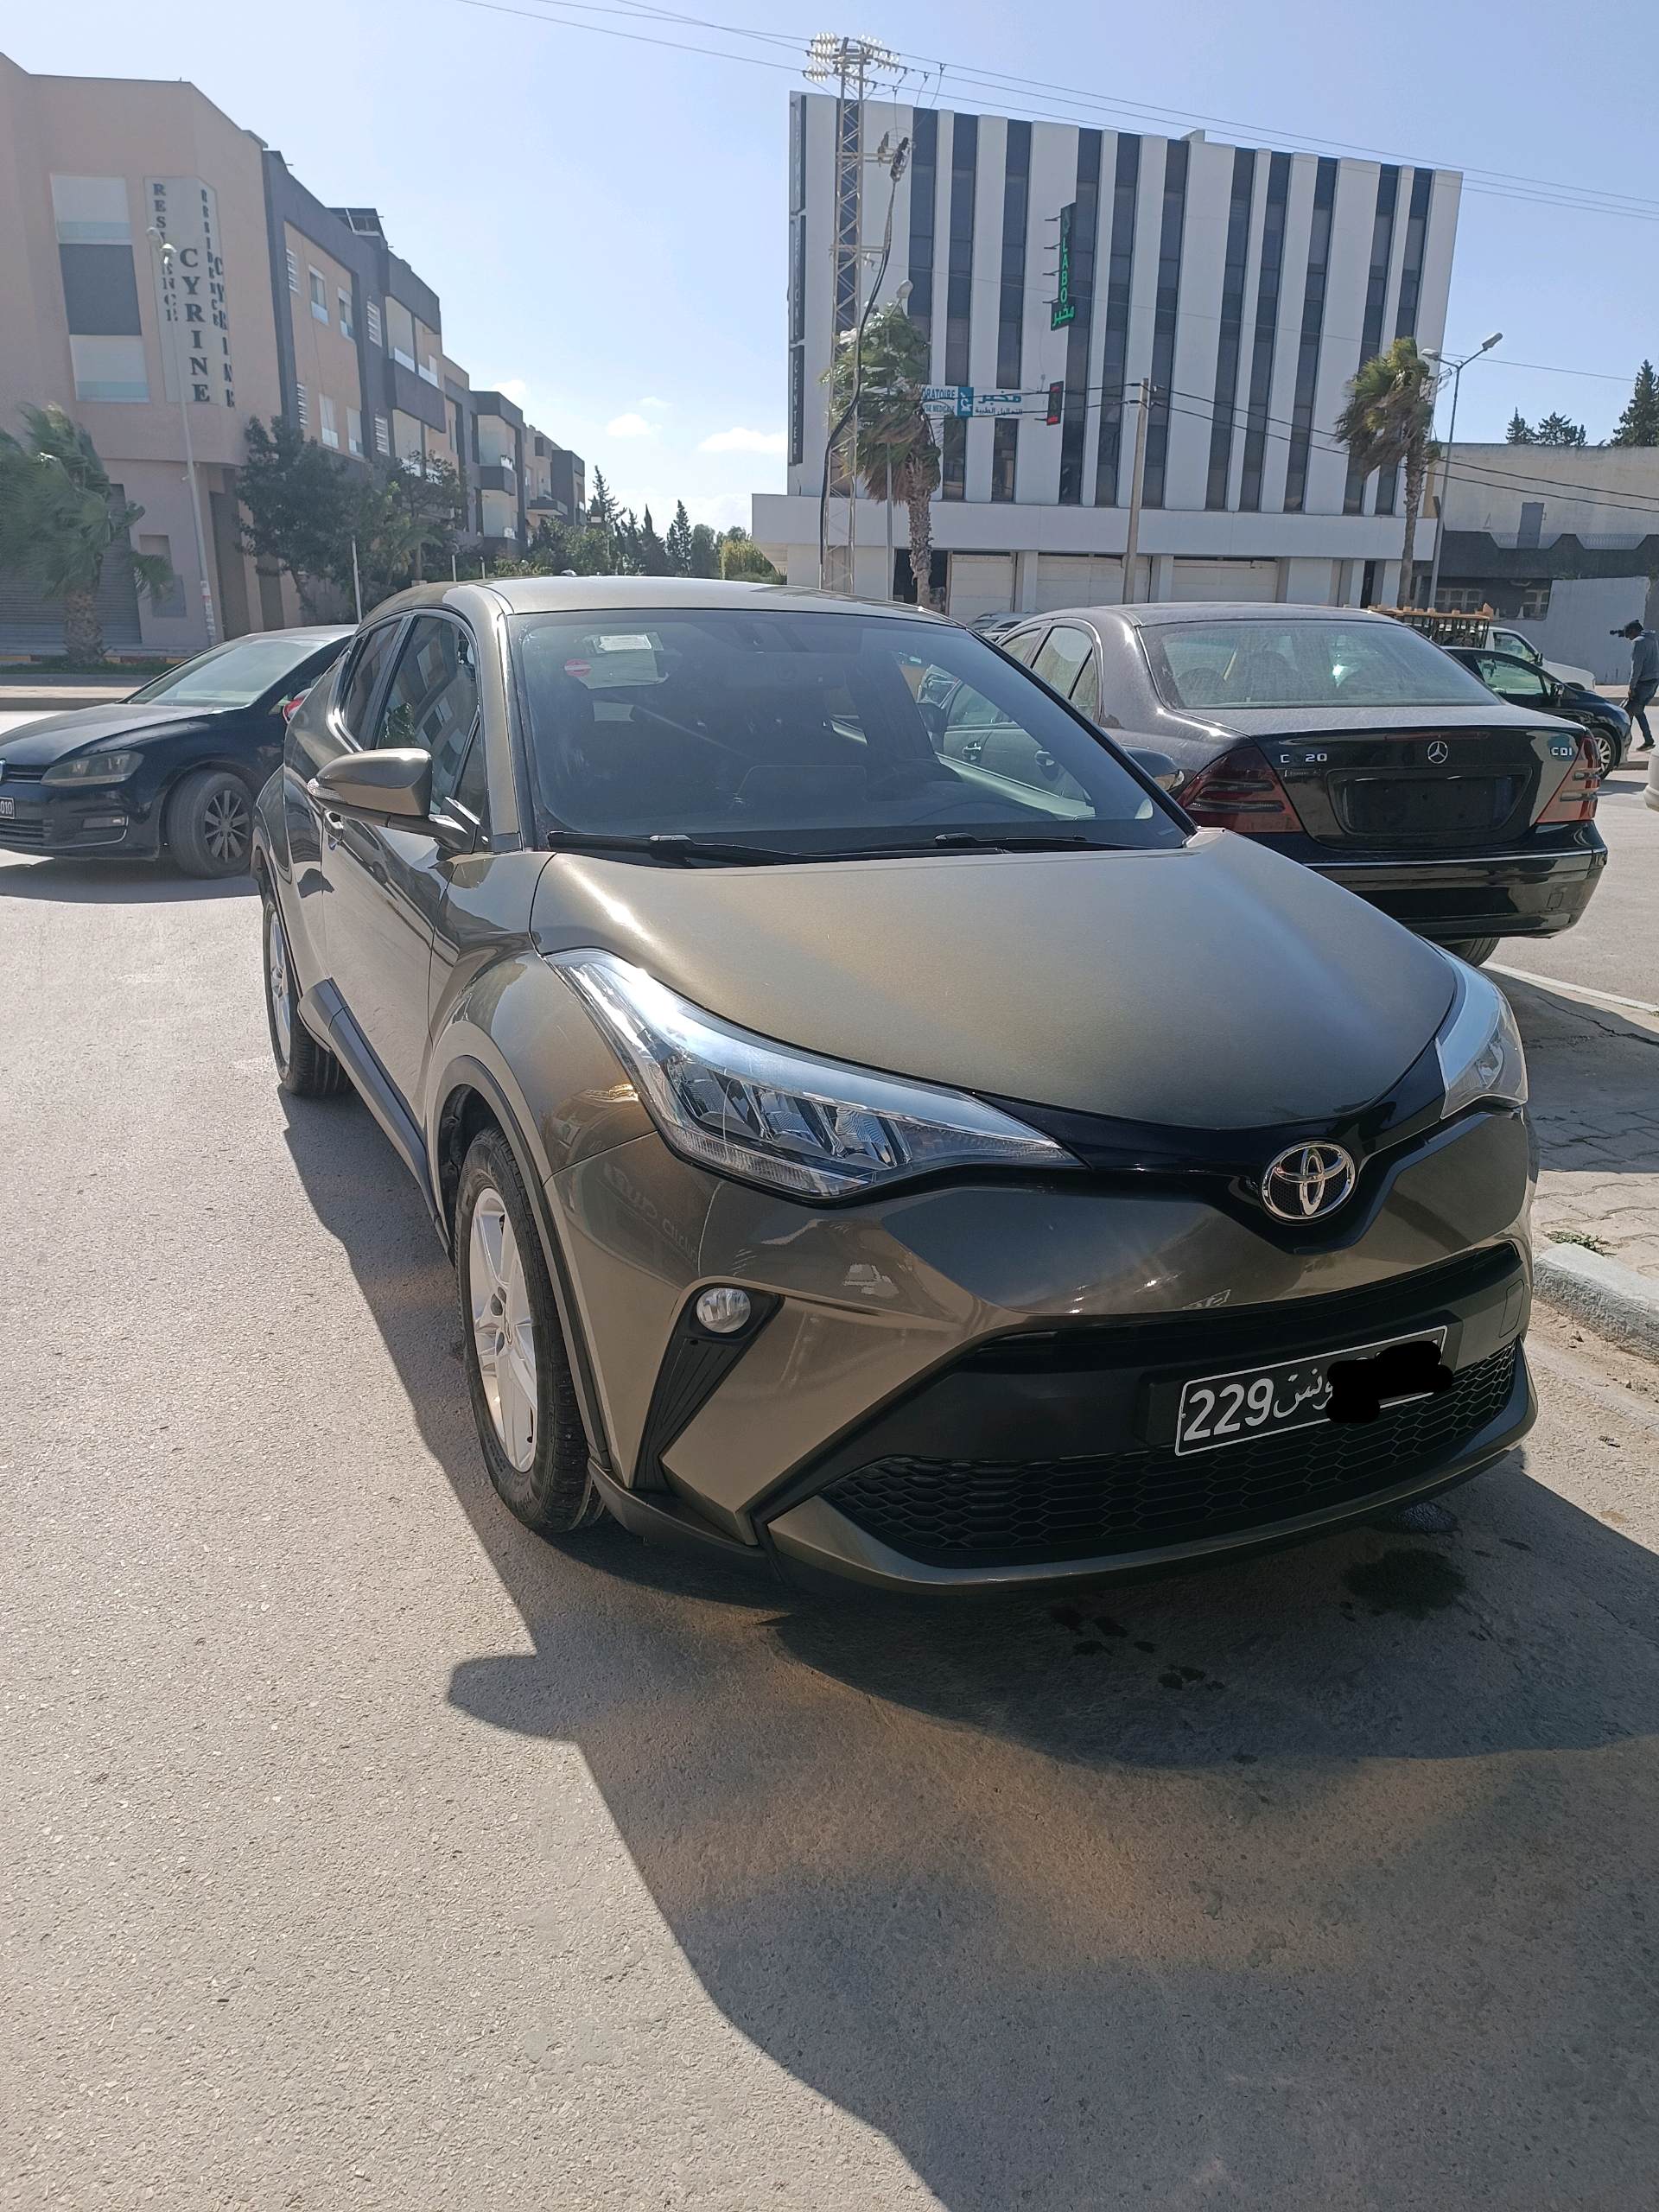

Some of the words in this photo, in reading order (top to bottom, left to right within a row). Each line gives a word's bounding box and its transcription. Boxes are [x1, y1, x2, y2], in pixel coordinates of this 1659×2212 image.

[1060, 237, 1069, 303] LABO
[180, 248, 210, 403] CYRINE
[1052, 304, 1075, 327] مخبر
[978, 391, 1021, 404] مخبر
[1280, 753, 1290, 763] C
[1305, 753, 1327, 762] 20
[1551, 747, 1573, 756] CDI
[1183, 1378, 1274, 1441] 229
